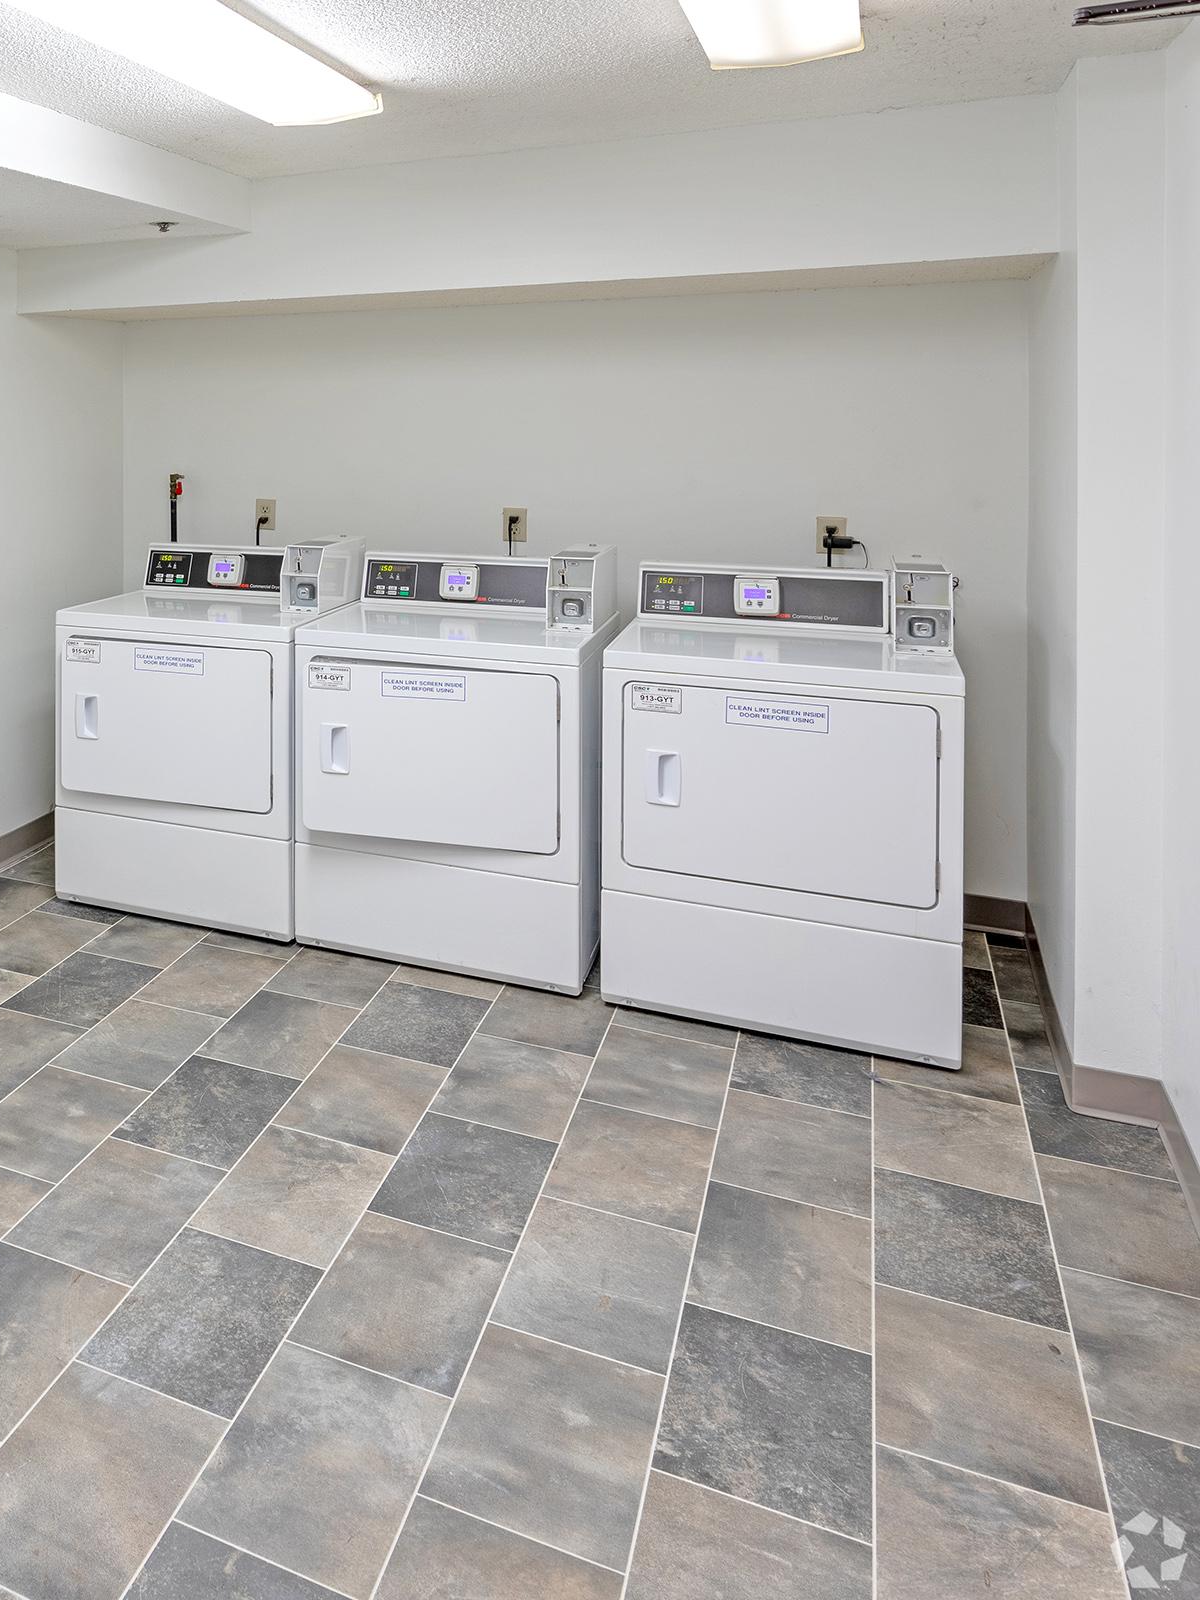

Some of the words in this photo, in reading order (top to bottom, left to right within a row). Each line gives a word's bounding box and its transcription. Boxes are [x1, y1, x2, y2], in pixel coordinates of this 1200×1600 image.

[315, 673, 344, 682] 914-GYT
[640, 694, 674, 703] 913-GYT
[728, 704, 753, 712] CLEAN
[771, 708, 801, 716] SCREEN
[802, 710, 826, 718] INSIDE
[762, 714, 791, 722] BEFORE
[792, 716, 815, 724] USING
